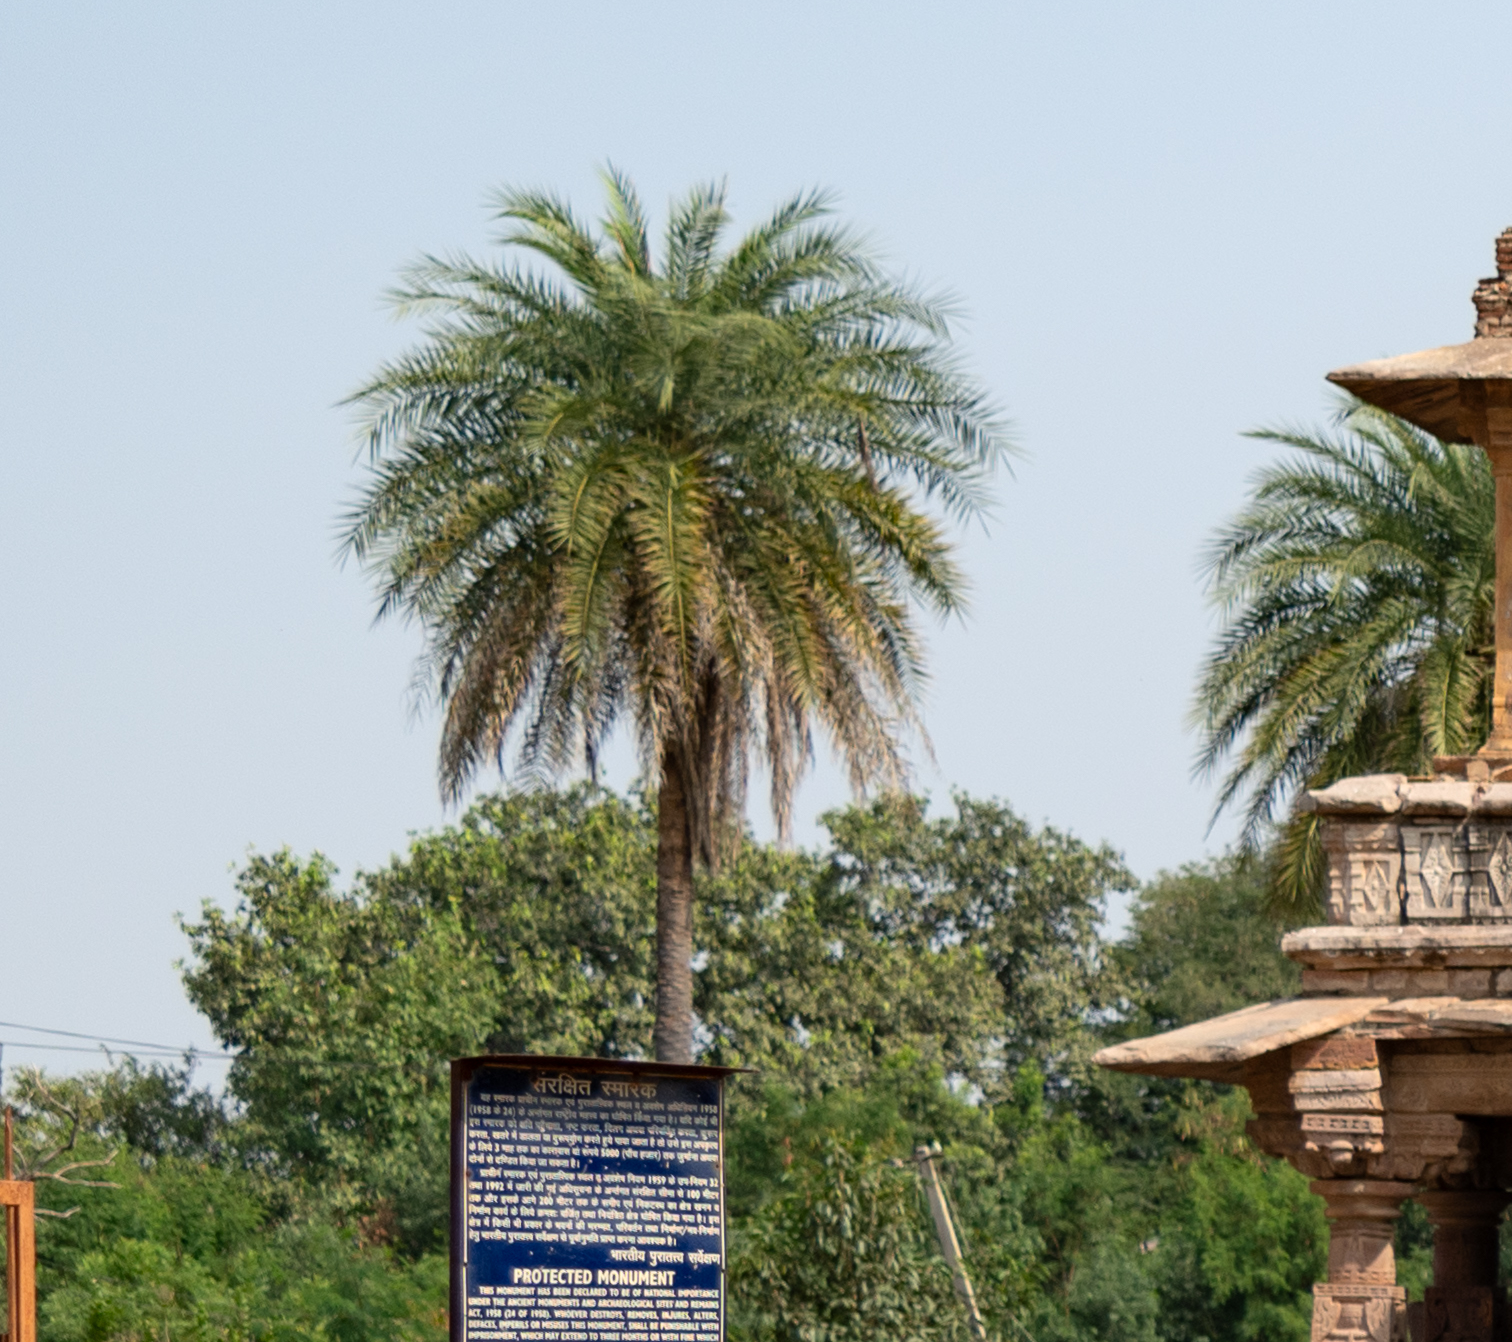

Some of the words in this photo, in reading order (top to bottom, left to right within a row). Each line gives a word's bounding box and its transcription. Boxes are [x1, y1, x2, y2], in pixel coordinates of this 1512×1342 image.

[601, 1080, 657, 1098] स्मारक
[648, 1175, 666, 1185] 1959
[485, 1181, 504, 1191] 1992
[610, 1246, 645, 1262] भारतीय
[688, 1249, 721, 1265] सर्वेक्षण
[514, 1269, 593, 1285] PROTECTED
[597, 1270, 676, 1286] MONUMENT
[480, 1287, 494, 1295] THIS
[496, 1287, 535, 1296] MONUMENT
[538, 1288, 551, 1296] HAS
[553, 1288, 571, 1296] BEEN
[573, 1288, 607, 1297] DECLARED
[609, 1288, 619, 1297] TO
[622, 1289, 630, 1297] BE
[632, 1289, 642, 1297] OF
[644, 1289, 676, 1297] NATIONAL
[678, 1289, 719, 1298] IMPORTANCE
[468, 1298, 490, 1306] UNDER
[492, 1298, 506, 1307] THE
[507, 1298, 535, 1307] ANCIENT
[538, 1299, 580, 1307] MONUMENTS
[582, 1299, 596, 1307] AND
[598, 1299, 654, 1308] ARCHAEOLOGICAL
[656, 1300, 674, 1308] SITES
[675, 1300, 689, 1308] AND
[691, 1300, 719, 1309] REMAINS
[486, 1309, 502, 1318] 1958
[518, 1310, 528, 1318] OF
[554, 1310, 587, 1318] WHOEVER
[499, 1321, 529, 1329] IMPERILS
[530, 1321, 540, 1329] OR
[542, 1321, 569, 1329] MISUSES
[571, 1321, 586, 1330] THIS
[628, 1322, 648, 1330] SHALL
[650, 1322, 659, 1330] BE
[660, 1322, 700, 1331] PUNISHABLE
[701, 1322, 719, 1331] WITH
[521, 1332, 543, 1340] WHICH
[545, 1332, 560, 1340] MAY
[561, 1332, 587, 1341] EXTEND
[589, 1333, 598, 1341] TO
[600, 1333, 620, 1341] THREE
[621, 1333, 648, 1341] MONTHS
[650, 1333, 659, 1341] OR
[661, 1333, 679, 1341] WITH
[680, 1333, 695, 1341] FINE
[696, 1333, 719, 1342] WHICH
